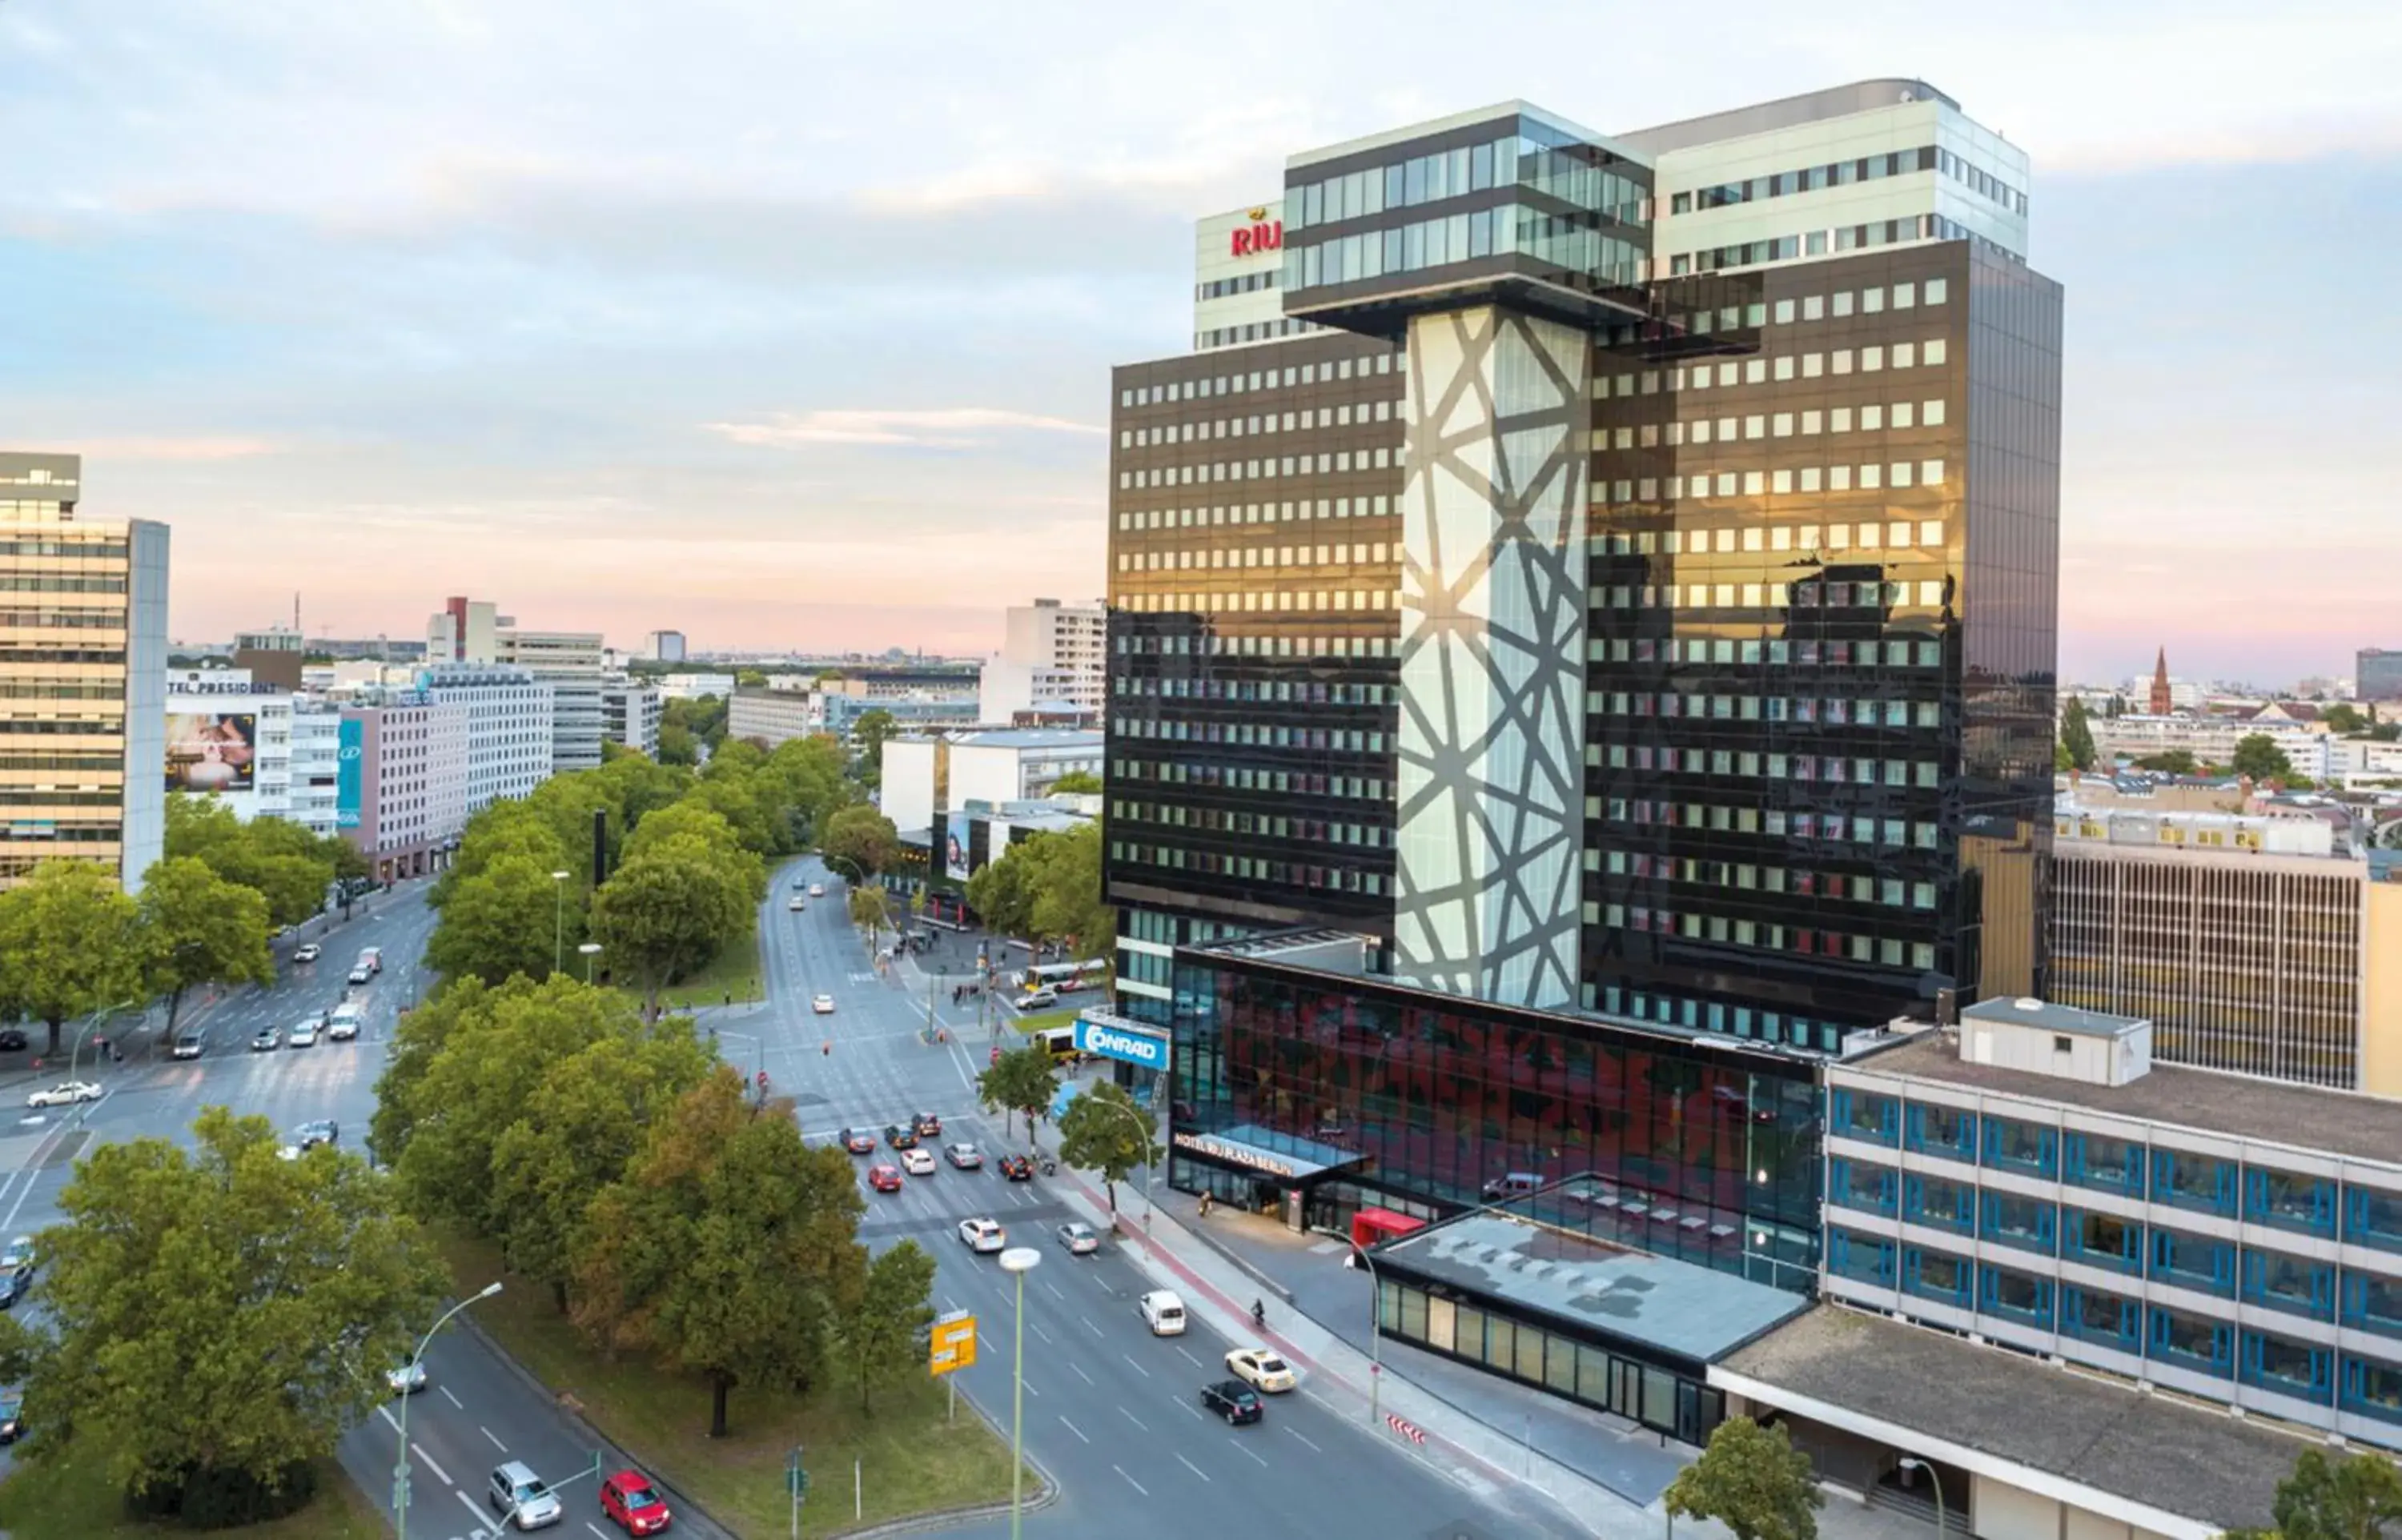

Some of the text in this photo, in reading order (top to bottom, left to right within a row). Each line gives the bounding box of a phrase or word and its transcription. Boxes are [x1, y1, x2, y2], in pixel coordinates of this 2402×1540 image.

[1231, 220, 1282, 256] RIU
[198, 682, 276, 694] PRESIDENT
[1085, 1025, 1156, 1059] CONRAD
[1175, 1133, 1205, 1151] HOTEL
[1224, 1147, 1255, 1165] PLAZA
[1255, 1155, 1294, 1177] BERLIN
